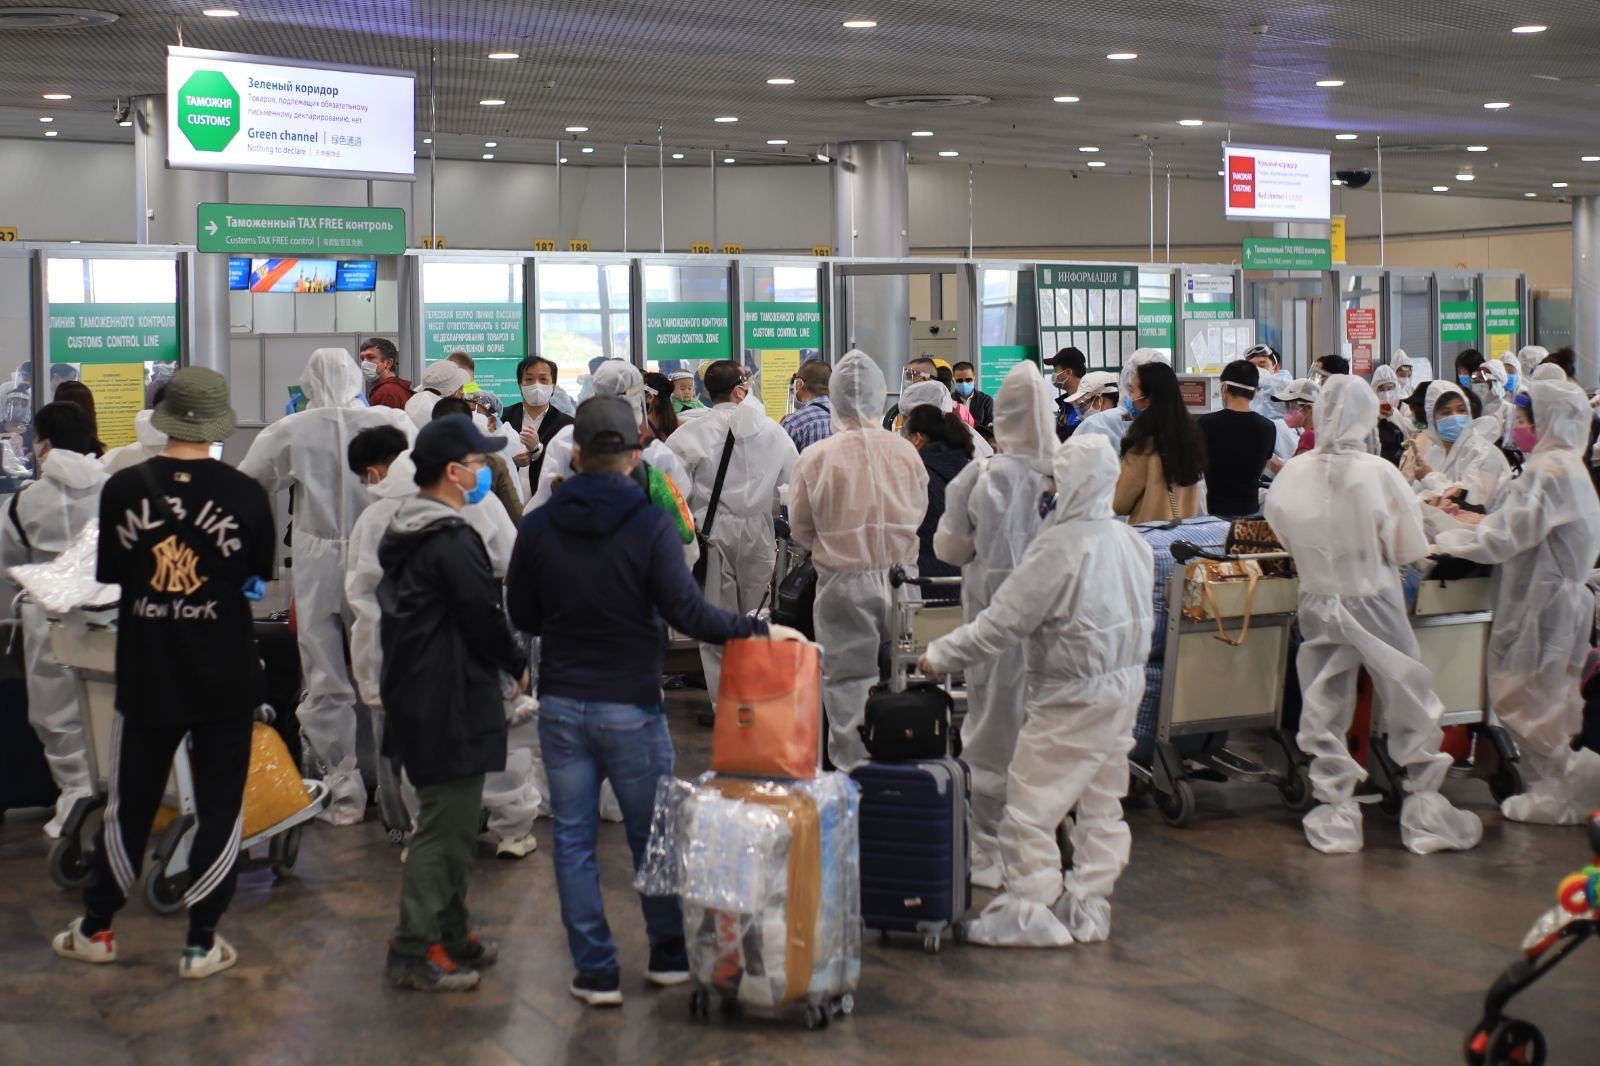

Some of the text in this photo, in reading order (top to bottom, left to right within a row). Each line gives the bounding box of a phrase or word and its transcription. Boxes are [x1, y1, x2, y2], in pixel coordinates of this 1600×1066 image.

[247, 77, 339, 98] Зеленый коридор
[185, 95, 233, 109] ТАМОЖНЯ
[321, 100, 369, 113] обязательному
[187, 114, 231, 127] CUSTOMS
[247, 127, 319, 143] Green channel
[247, 143, 307, 156] Nothing to declare
[225, 215, 394, 233] Таможенный TAX FREE контроль
[225, 235, 257, 245] Customs
[258, 236, 271, 245] TAX
[272, 236, 289, 245] FREE
[290, 236, 315, 246] control
[1058, 271, 1117, 285] ИНФОРМАЦИЯ
[49, 315, 176, 329] ЛИНИЯ ТАМОЖЕННОГО КОНТРОЛЯ
[647, 318, 662, 328] ЗОНА
[744, 312, 758, 322] ИНИЯ
[656, 333, 720, 345] CUSTOMS CONTROL ZONE
[752, 327, 811, 338] CUSTOMS CONTROL LINE
[67, 334, 160, 349] CUSTOMS CONTROL LINE
[486, 343, 505, 353] ФОРМЕ
[132, 596, 168, 619] New
